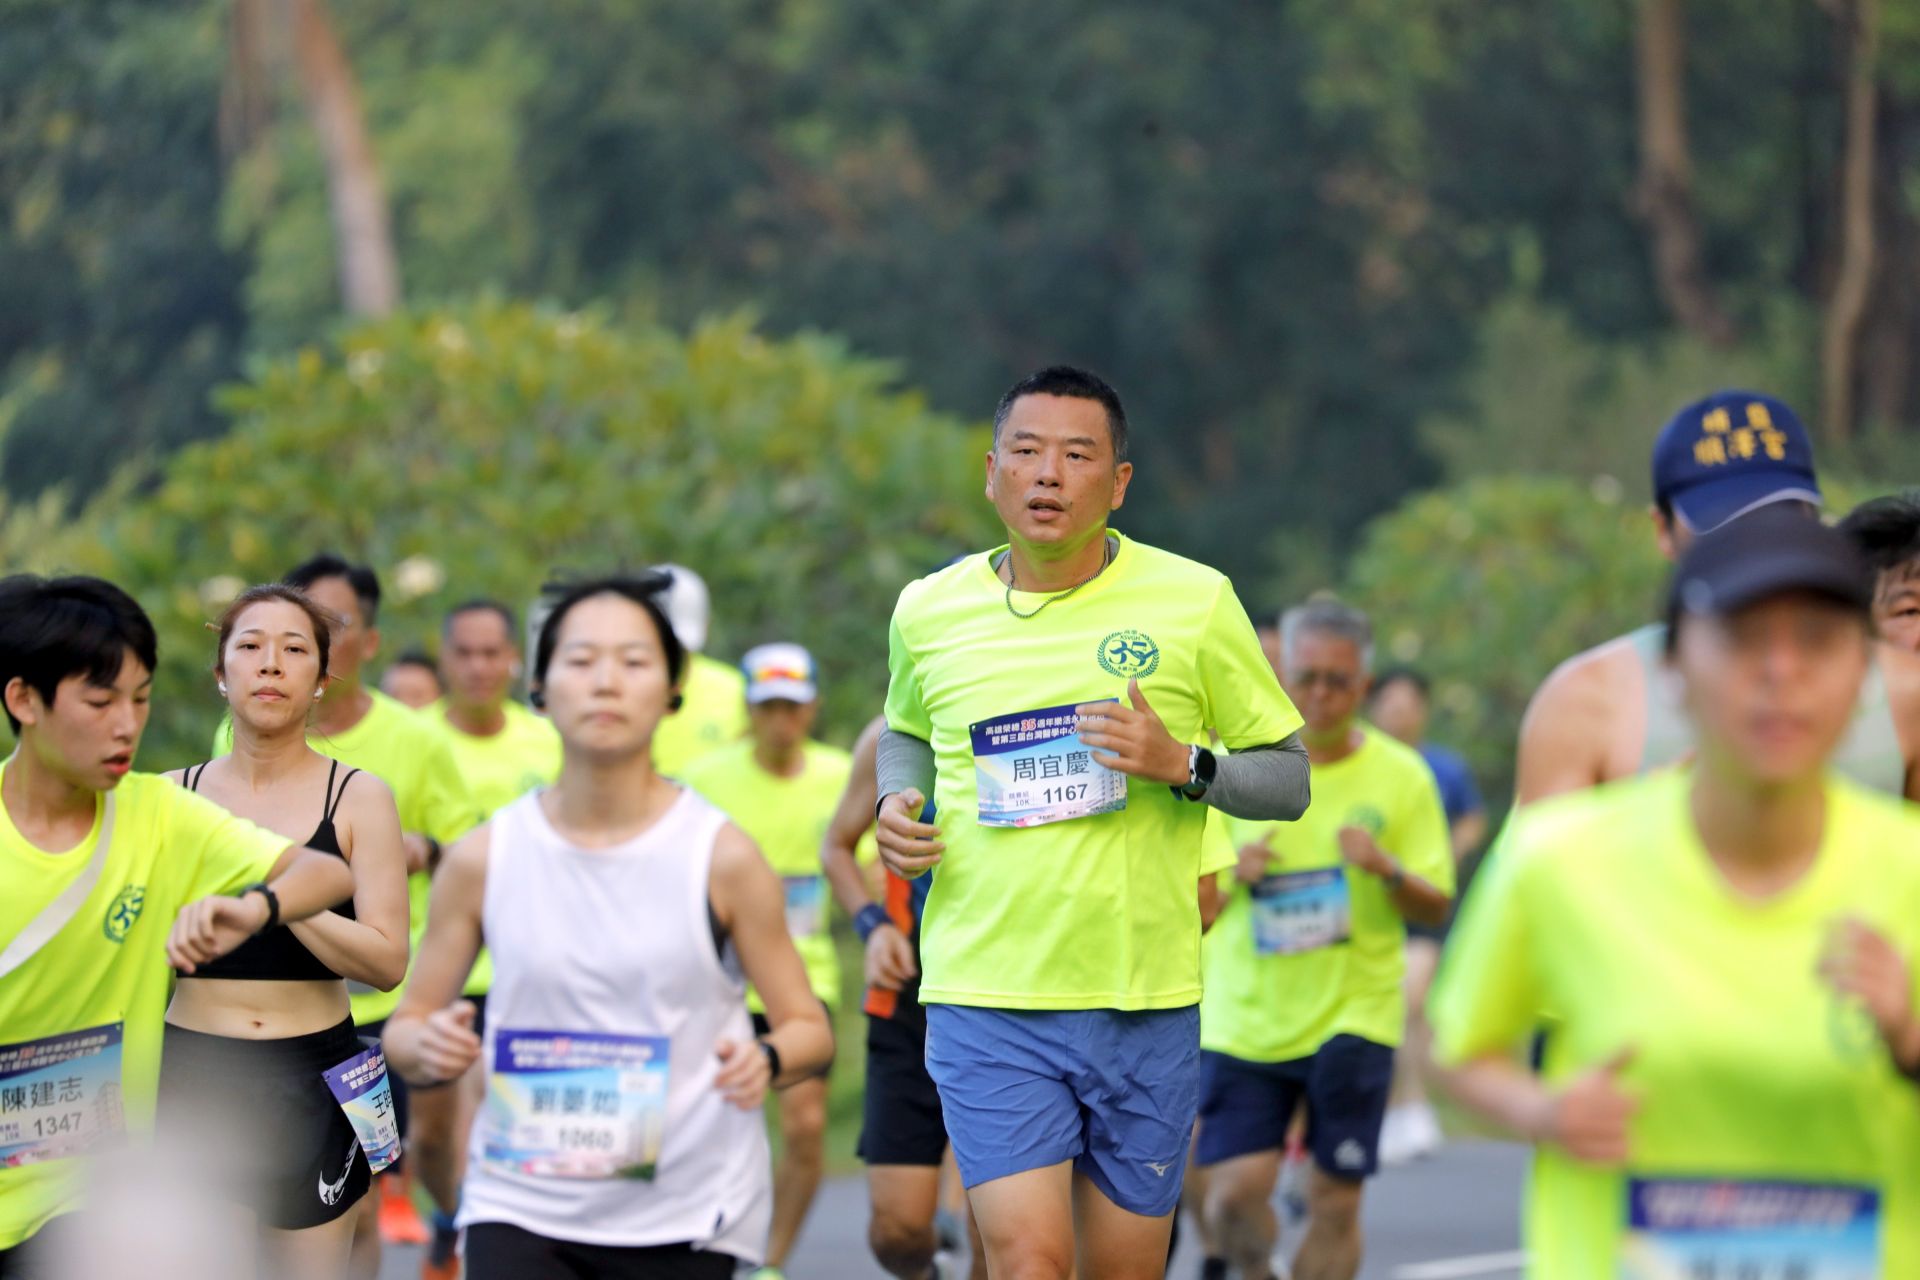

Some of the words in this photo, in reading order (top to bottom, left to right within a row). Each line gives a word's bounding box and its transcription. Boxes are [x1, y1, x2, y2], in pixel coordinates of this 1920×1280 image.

[1013, 750, 1090, 783] 周宜慶
[1043, 784, 1088, 804] 1167
[1, 1076, 83, 1115] 陳建志
[33, 1112, 82, 1137] 1347
